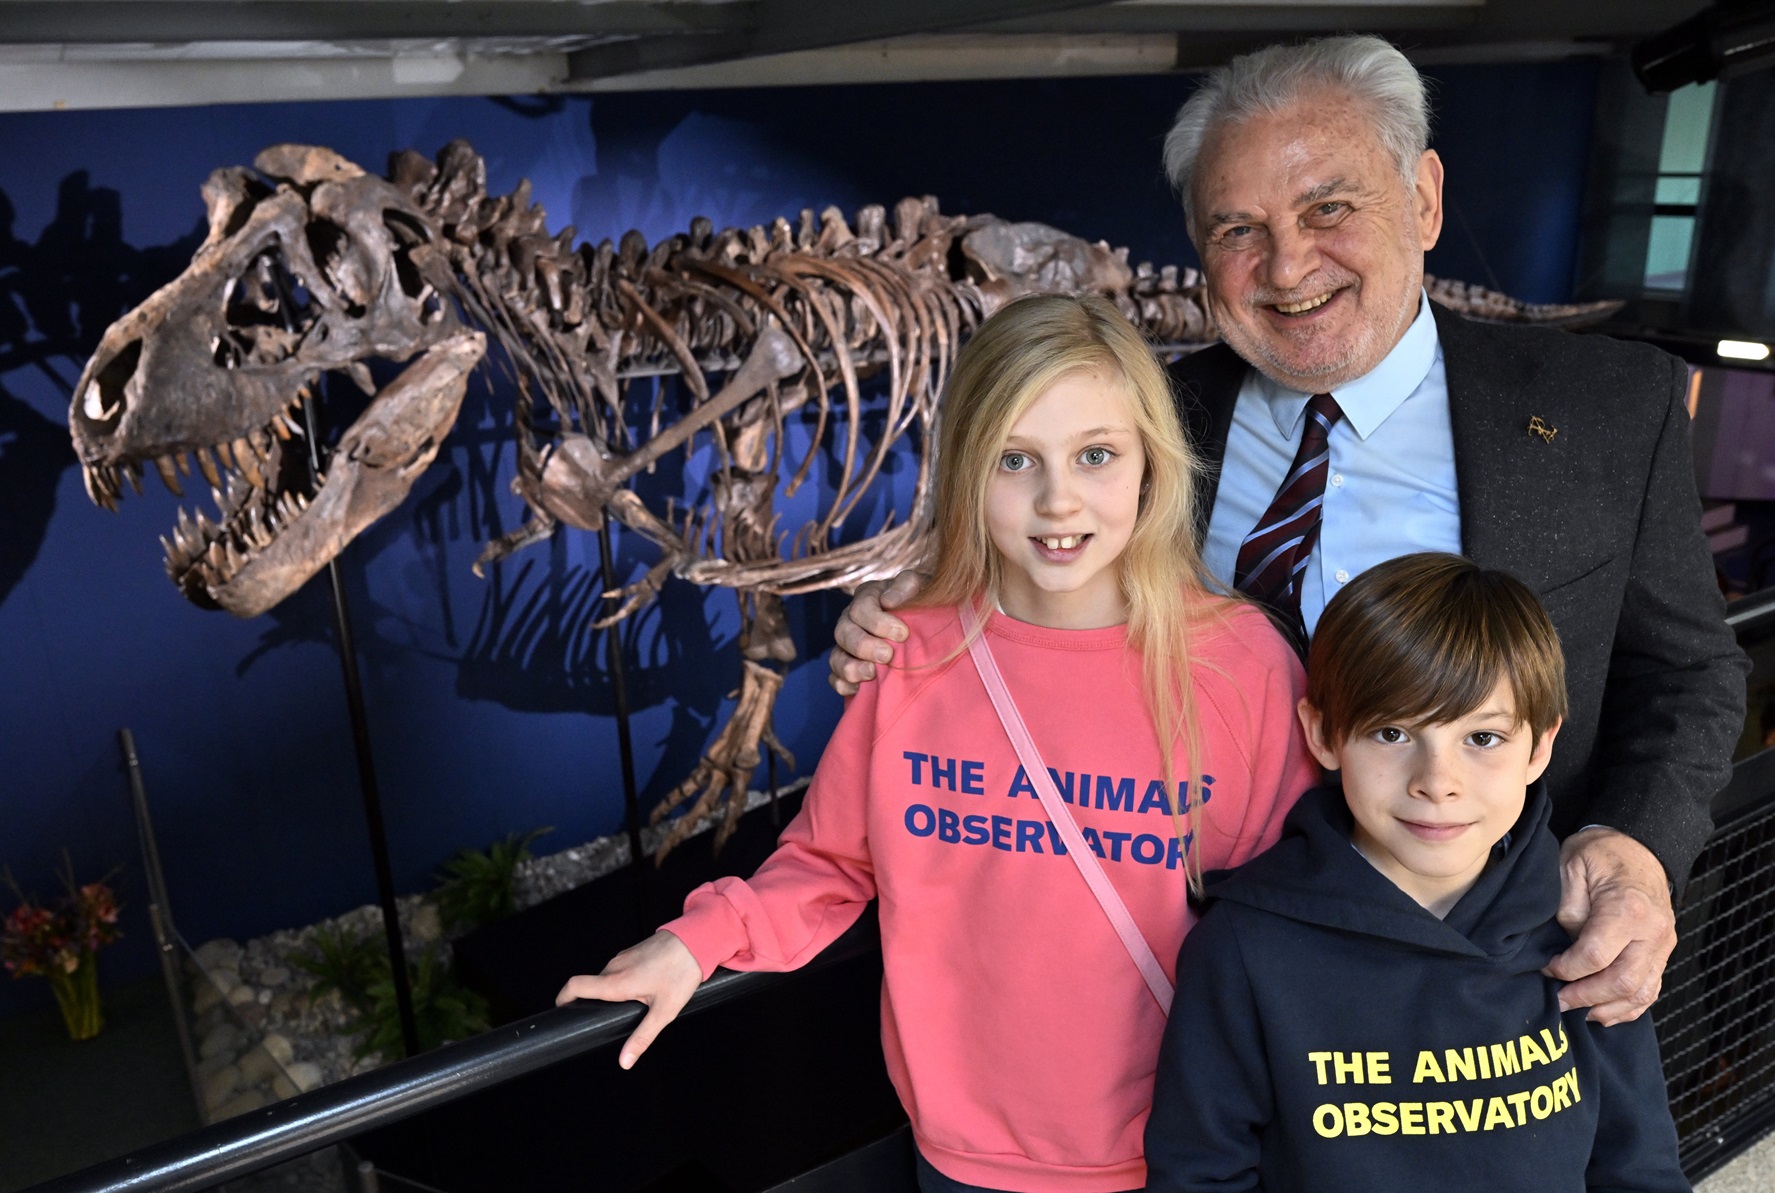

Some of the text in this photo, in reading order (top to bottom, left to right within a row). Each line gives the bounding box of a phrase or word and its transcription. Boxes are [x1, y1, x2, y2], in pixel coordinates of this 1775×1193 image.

[903, 751, 985, 796] THE
[1308, 1051, 1392, 1085] THE
[1312, 1067, 1582, 1138] OBSERVATORY
